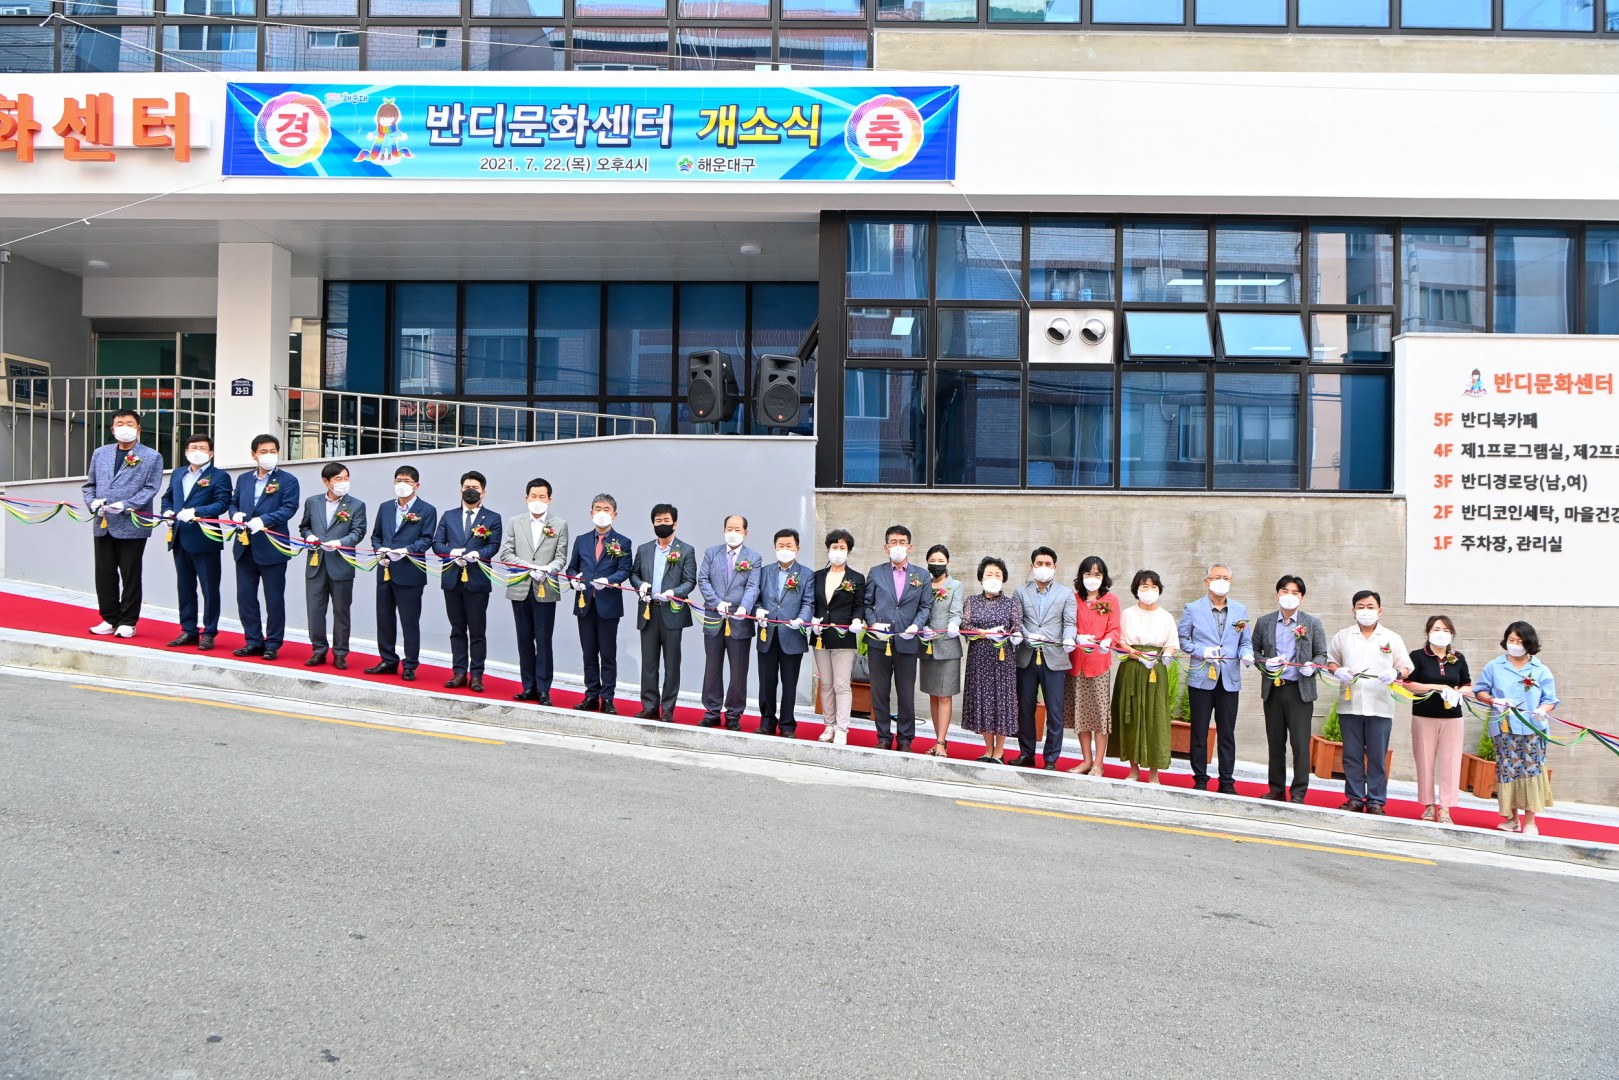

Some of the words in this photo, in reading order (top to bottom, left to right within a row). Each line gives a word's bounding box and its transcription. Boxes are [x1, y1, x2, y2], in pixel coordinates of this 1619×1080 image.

[275, 111, 311, 148] 경
[426, 102, 672, 149] 반디문화센터
[698, 103, 822, 149] 개소식
[864, 114, 904, 152] 축
[480, 158, 519, 171] 2021.
[526, 158, 538, 171] 7.
[544, 157, 591, 172] 22.(목)
[596, 157, 648, 172] 오후4시
[697, 157, 756, 173] 해운대구
[1493, 372, 1614, 395] 반디문화센터
[1433, 412, 1454, 427] 5F
[1461, 411, 1538, 429] 반디북카페
[1433, 443, 1454, 458] 4F
[1433, 474, 1454, 489] 3F
[1461, 473, 1588, 493] 반디경로당(남,여)
[1433, 504, 1454, 520] 2F
[1461, 504, 1560, 524] 반디코인세탁,
[1433, 535, 1453, 550] 1F
[1460, 535, 1513, 553] 주차장,
[1515, 535, 1563, 553] 관리실
